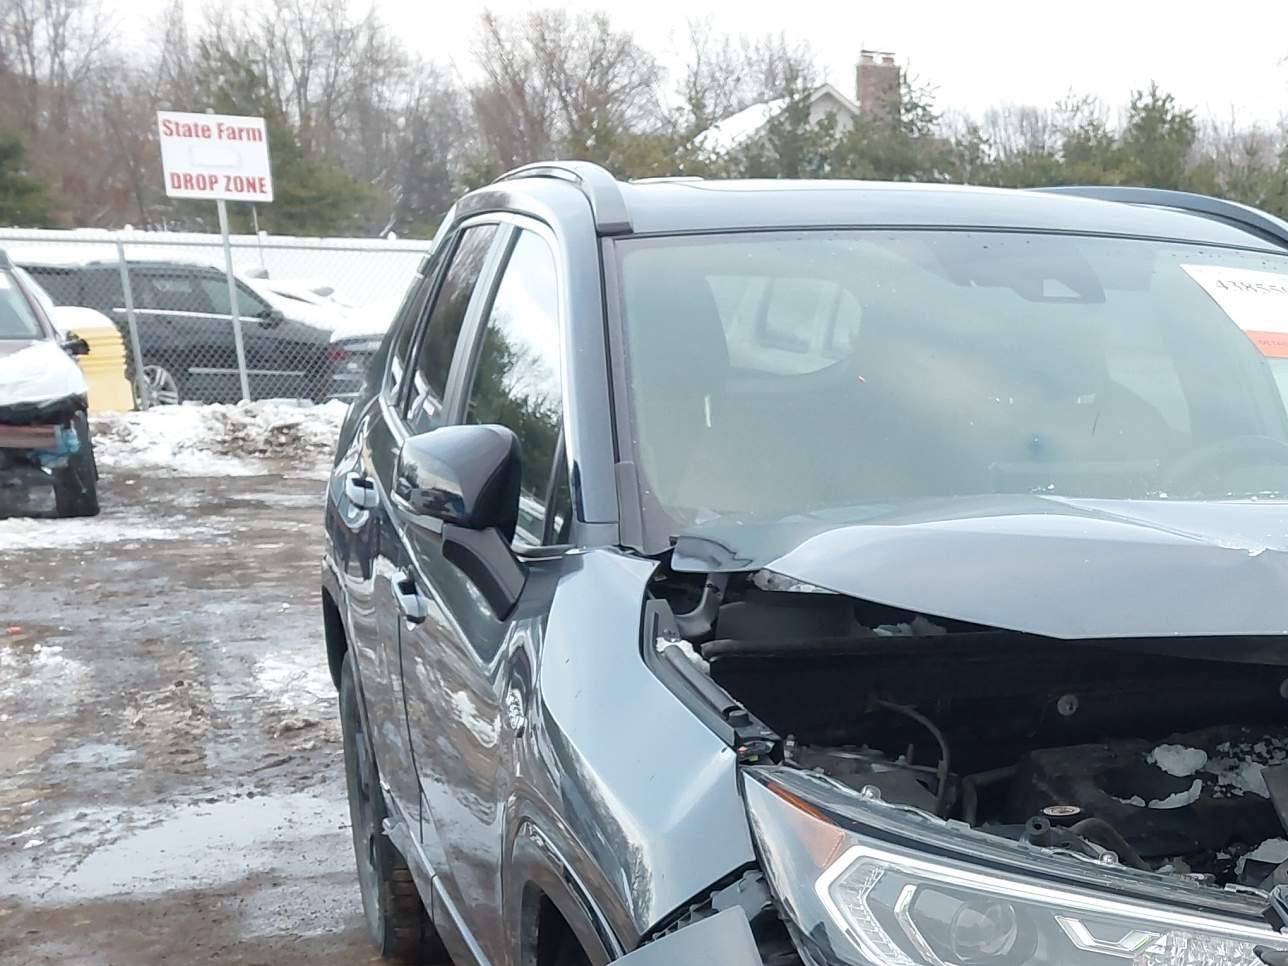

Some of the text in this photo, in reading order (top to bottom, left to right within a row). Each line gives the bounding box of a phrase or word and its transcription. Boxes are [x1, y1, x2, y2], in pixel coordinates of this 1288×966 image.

[162, 119, 263, 142] State Farm
[170, 172, 267, 194] DROP ZONE
